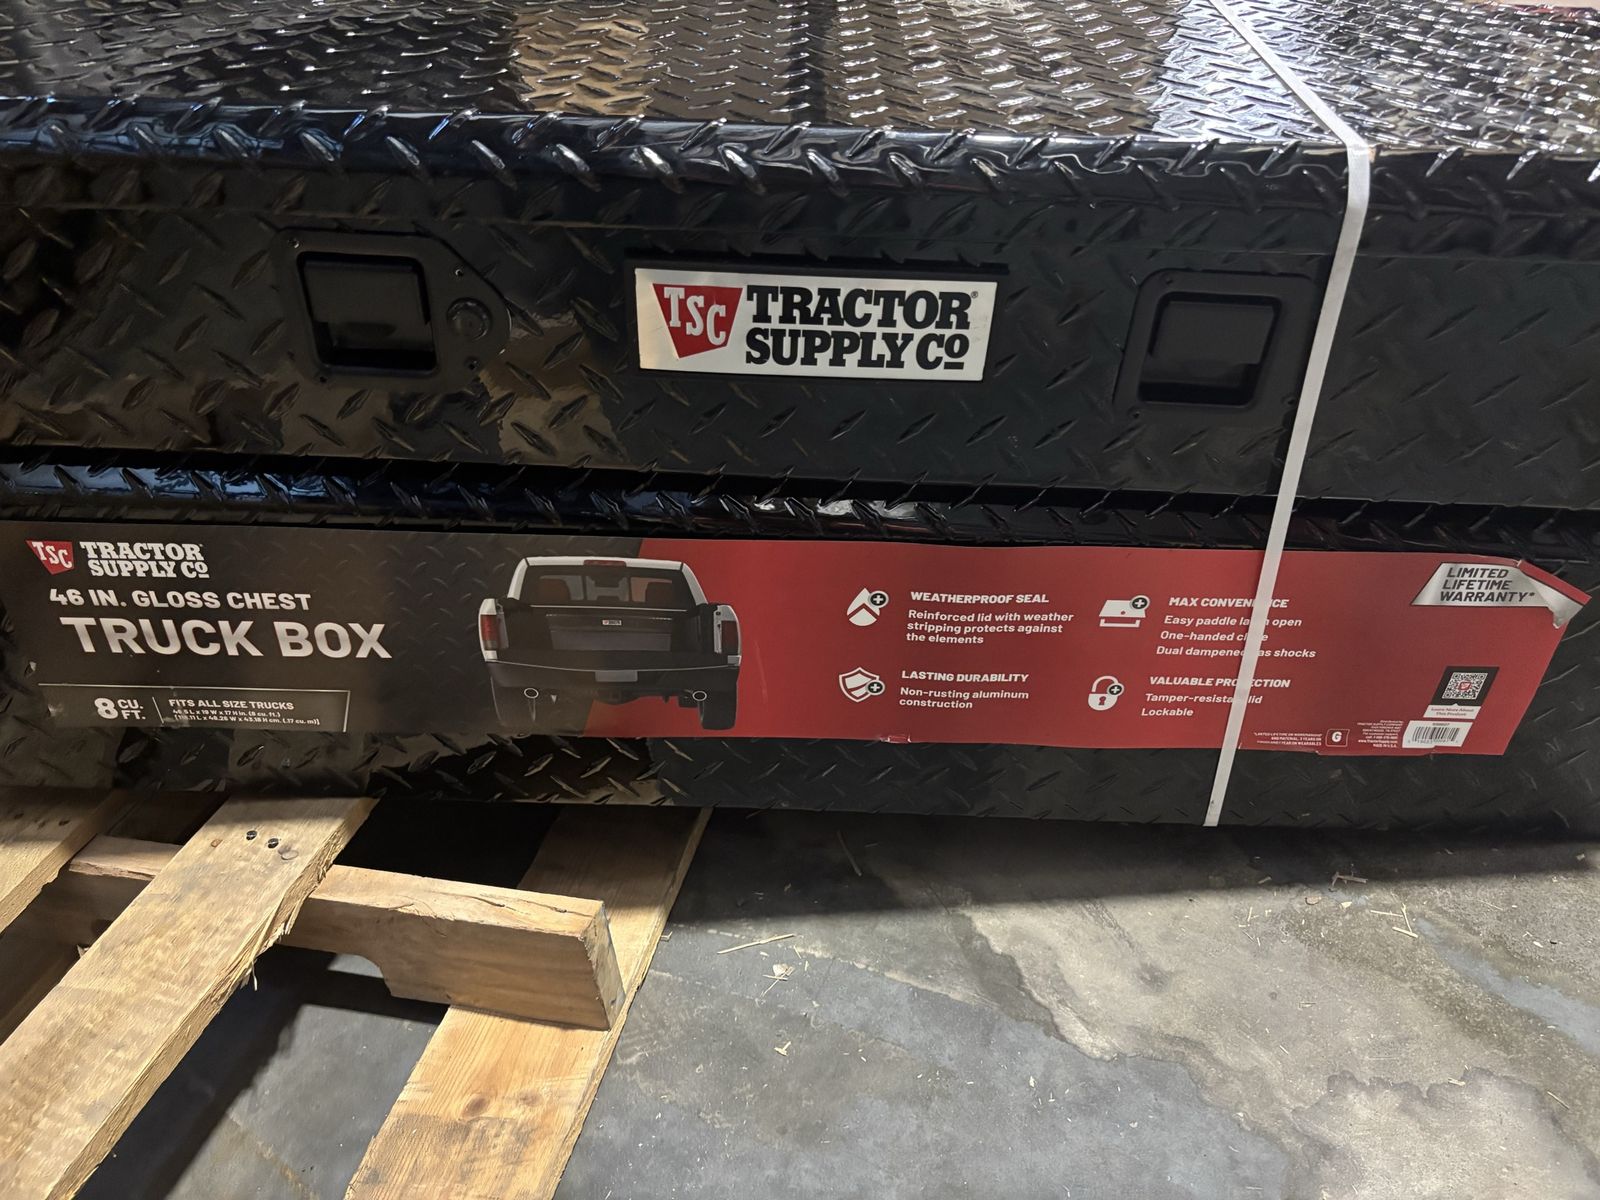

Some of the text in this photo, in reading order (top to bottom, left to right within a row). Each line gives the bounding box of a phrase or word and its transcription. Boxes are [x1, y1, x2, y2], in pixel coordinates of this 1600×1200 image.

[664, 287, 727, 346] TSC
[745, 328, 913, 370] SUPPLY
[38, 541, 73, 569] TSC
[79, 541, 205, 561] TRACTOR
[88, 559, 177, 578] SUPPLY
[1447, 567, 1509, 579] LIMITED
[1442, 579, 1513, 591] LIFETIME
[49, 588, 311, 610] 46 IN. GLOSS CHEST
[911, 591, 1050, 604] WEATHERPROOF SEAL
[1168, 597, 1201, 607] MAX
[908, 609, 1075, 622] Reinforced lid with weather
[1164, 615, 1194, 627] Easy
[1195, 616, 1238, 627] paddle
[1271, 619, 1303, 628] open
[906, 622, 1064, 635] stripping protects against
[59, 616, 393, 659] TRUCK BOX
[906, 633, 984, 644] the elements
[1160, 631, 1269, 642] One-handed cle
[1156, 646, 1184, 655] Dual
[1273, 649, 1317, 658] shocks
[901, 670, 1029, 683] LASTING DURABILITY
[1150, 676, 1214, 686] VALUABLE
[900, 687, 1029, 700] Non-rusting aluminum
[1247, 695, 1263, 704] lid
[94, 697, 119, 719] 8
[118, 699, 144, 710] CU.
[168, 699, 295, 710] FITS ALL SIZE TRUCKS
[899, 698, 973, 709] construction
[123, 709, 146, 720] FT.
[1141, 708, 1194, 716] Lockable
[1331, 731, 1342, 742] G
